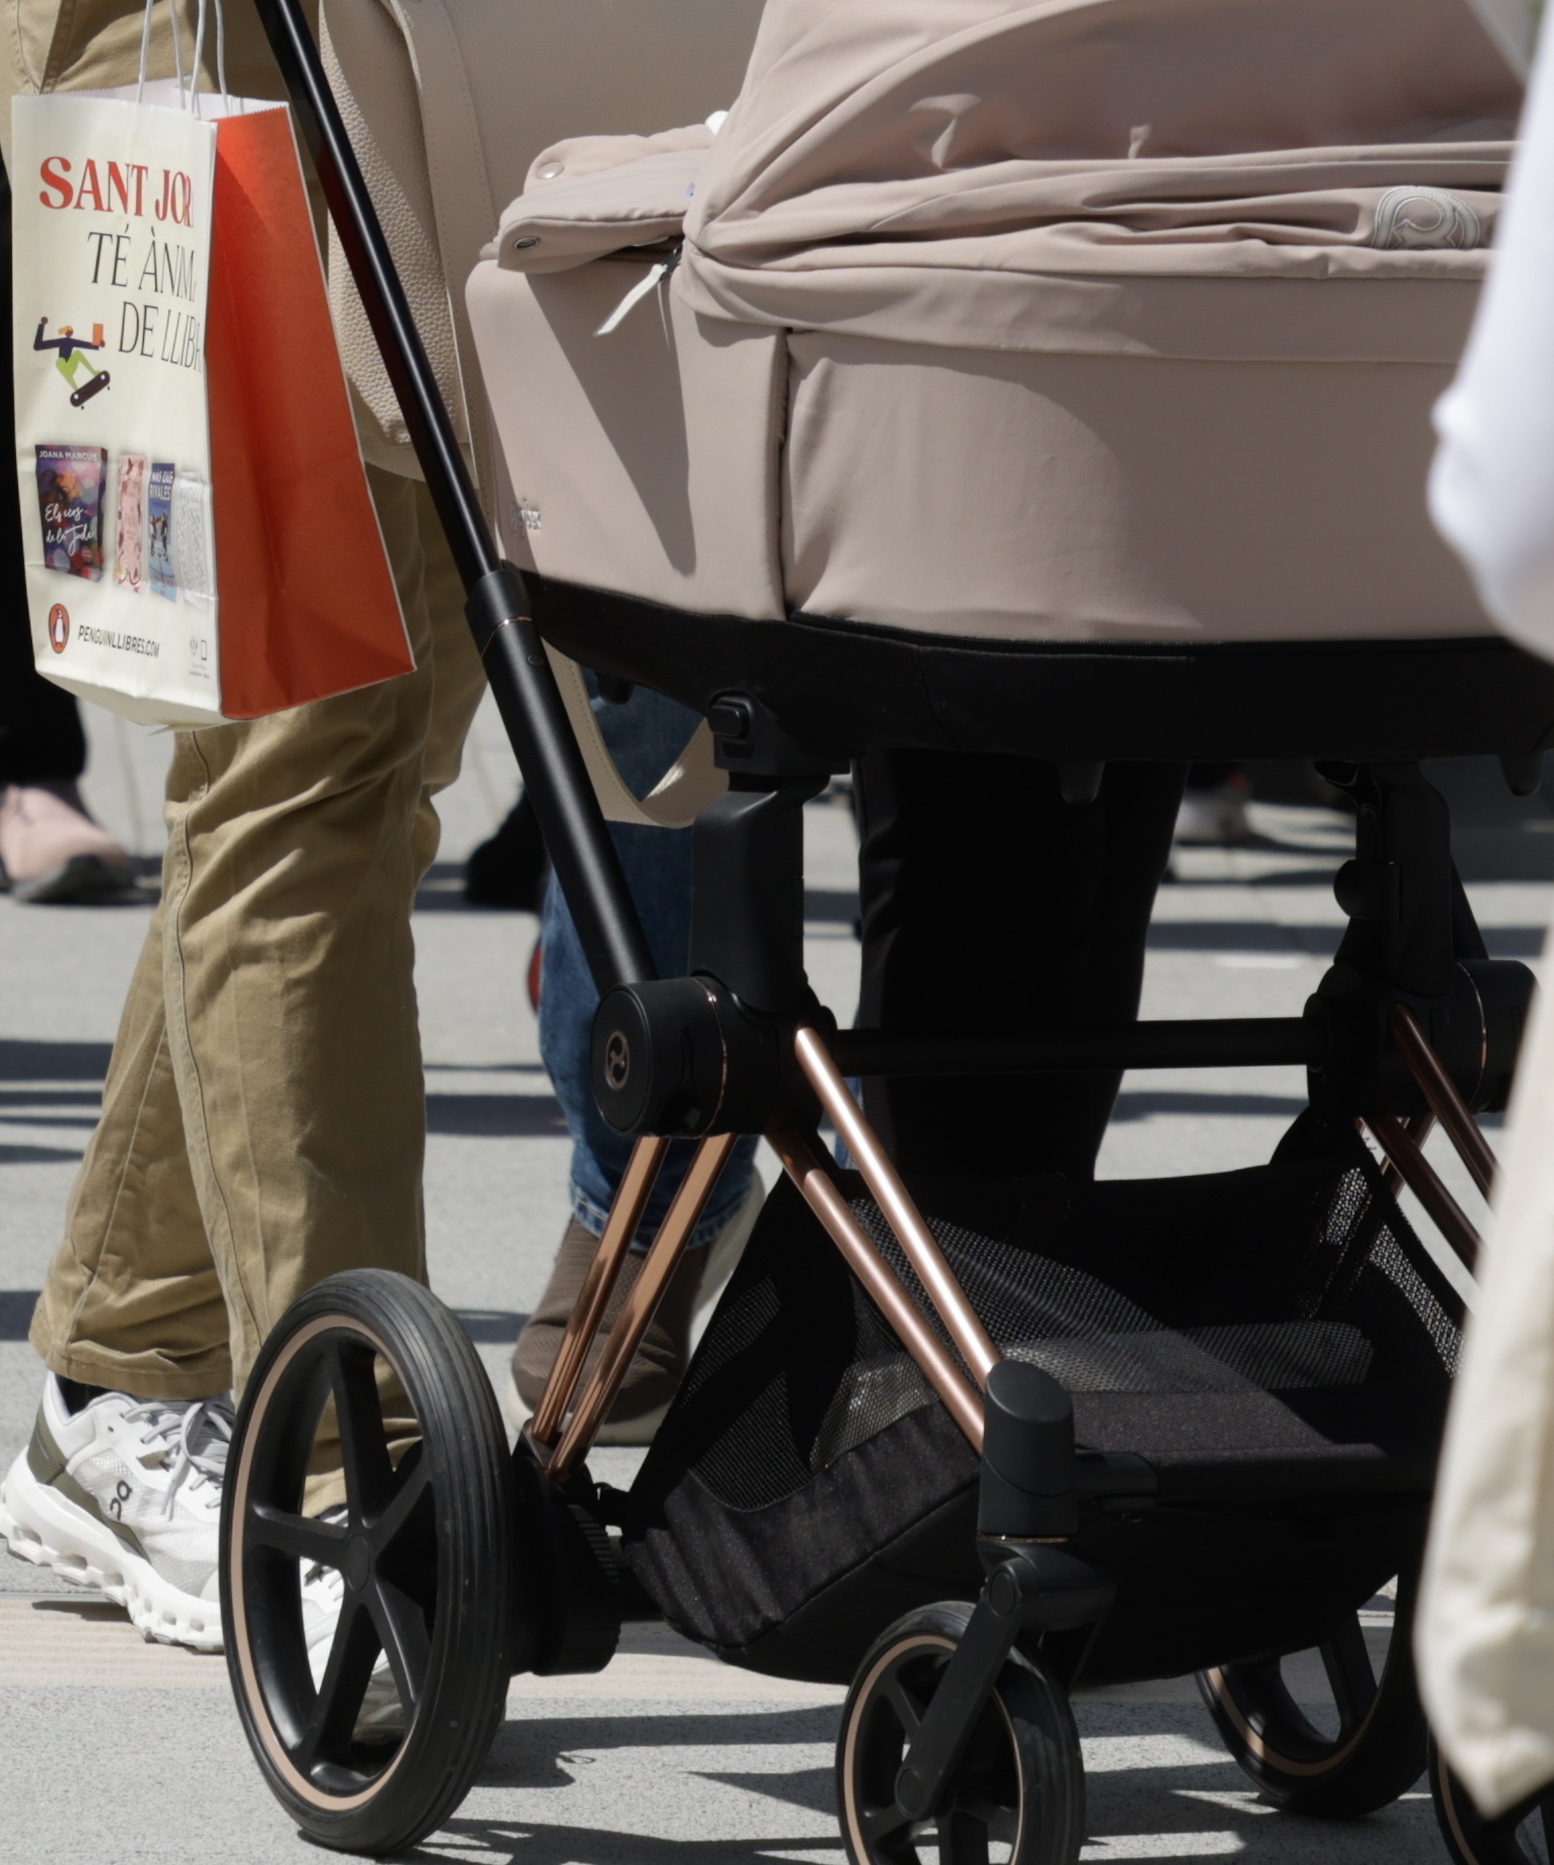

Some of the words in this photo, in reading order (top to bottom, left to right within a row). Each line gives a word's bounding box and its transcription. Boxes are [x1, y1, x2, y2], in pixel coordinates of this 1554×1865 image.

[39, 156, 149, 217] SANT
[87, 223, 131, 287] TÉ
[138, 225, 197, 302] ÀNIM
[118, 301, 159, 358] DE
[39, 450, 64, 459] JOANA
[65, 451, 98, 461] MARCÚS
[149, 485, 172, 501] RIVALES
[78, 625, 161, 658] PENGUINLLIBRES.COM
